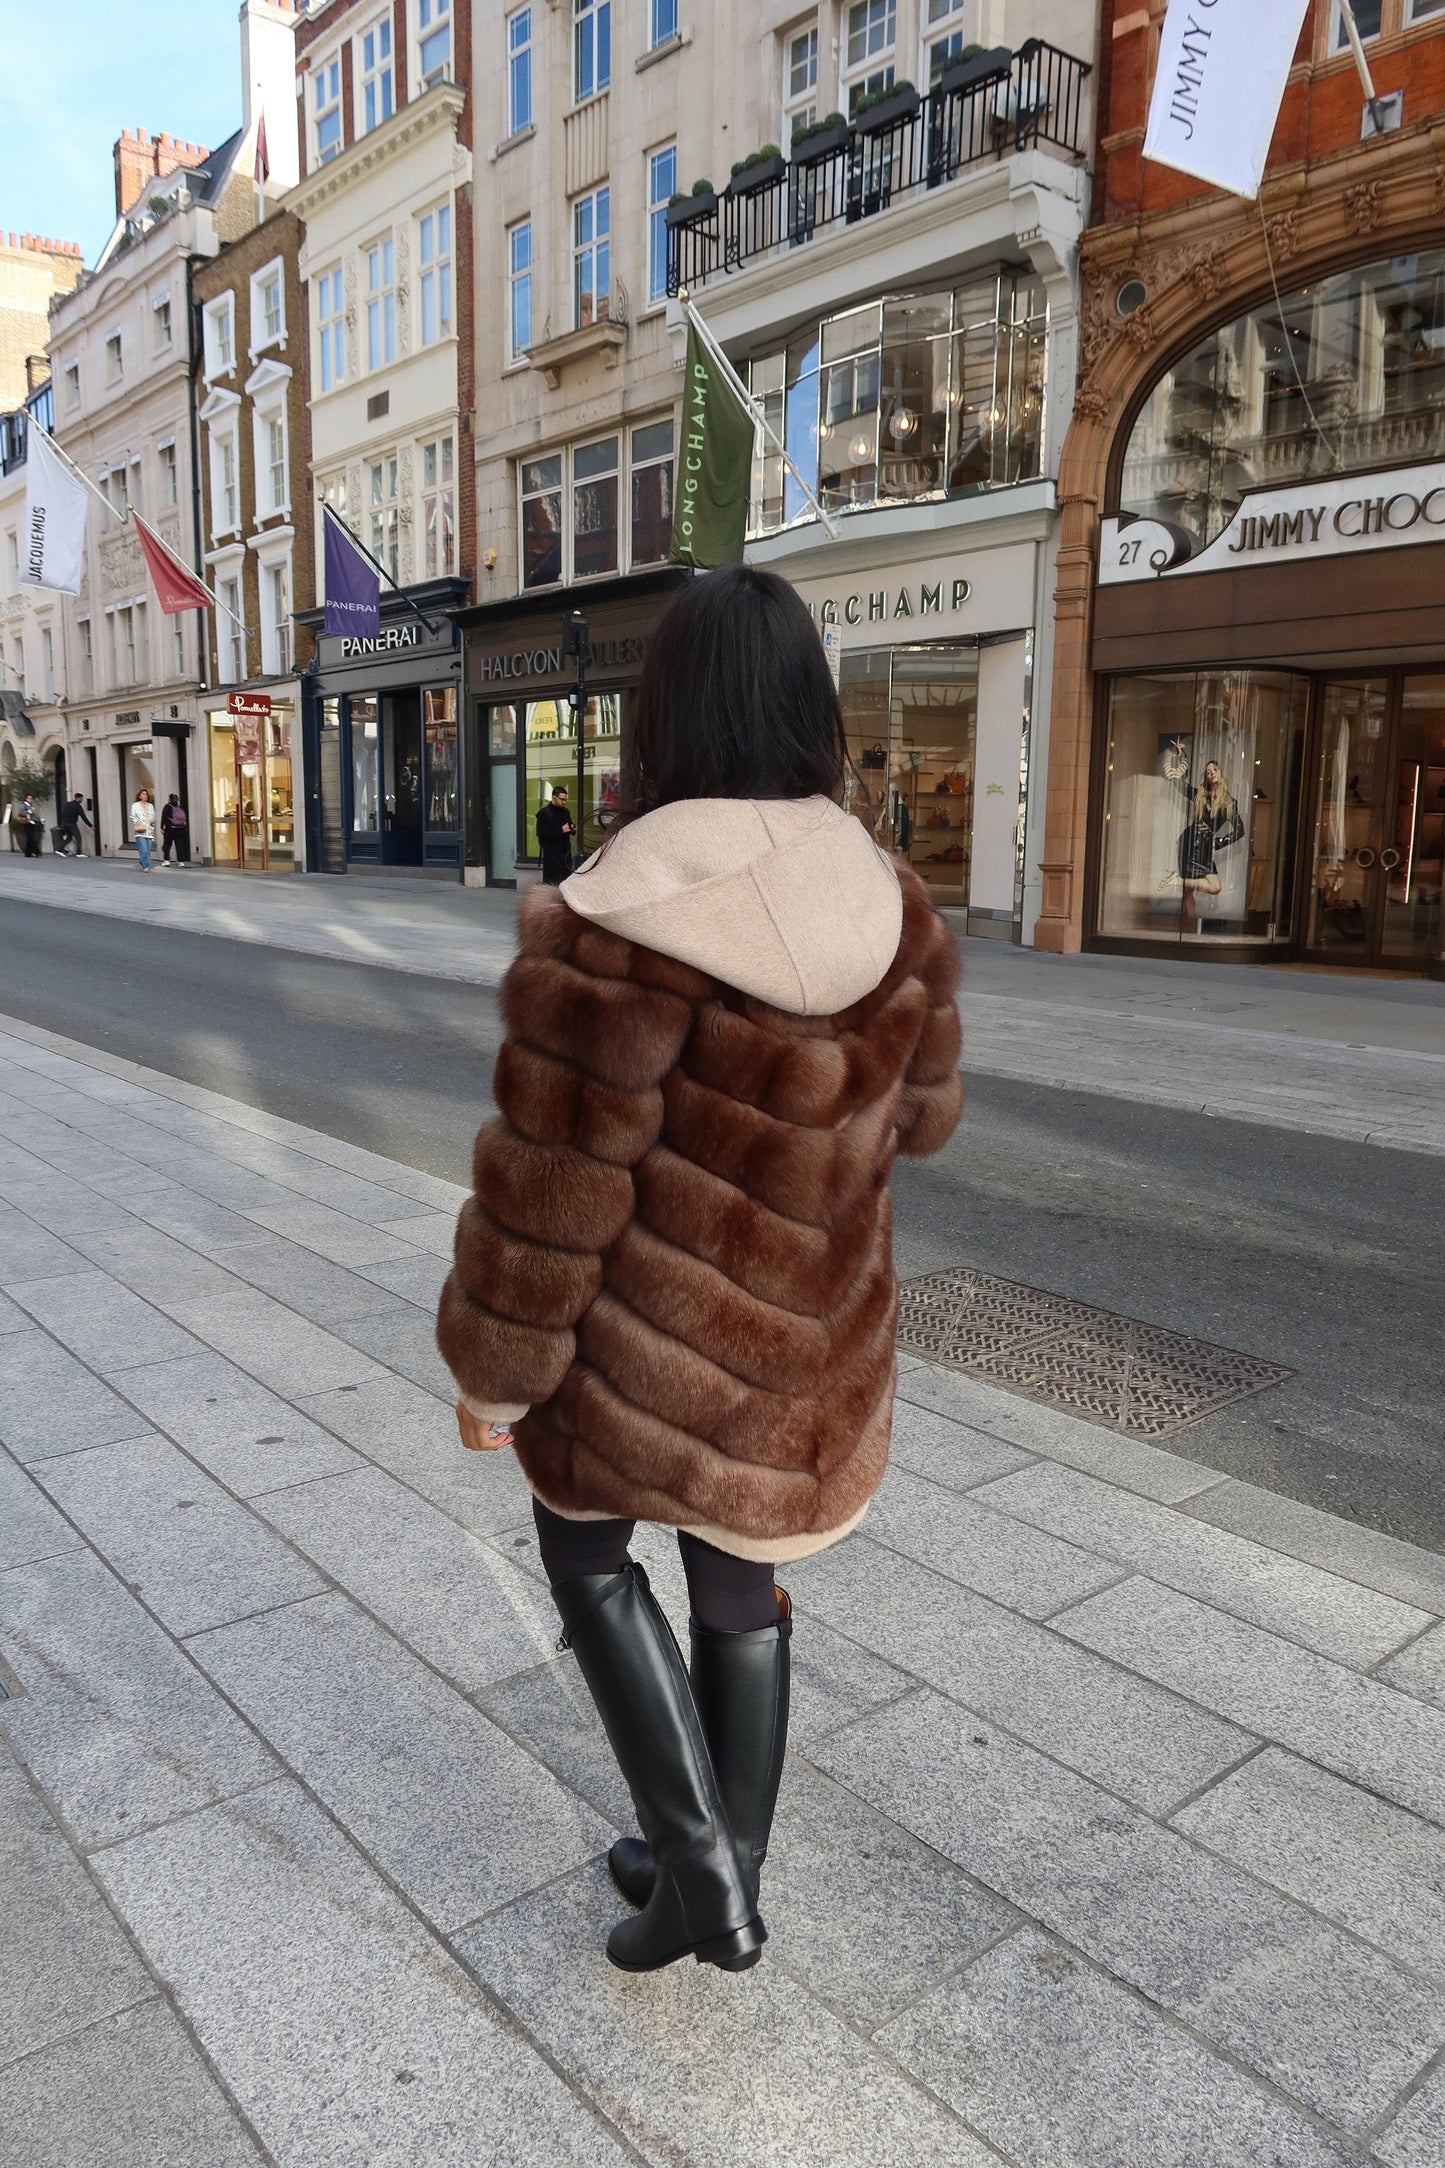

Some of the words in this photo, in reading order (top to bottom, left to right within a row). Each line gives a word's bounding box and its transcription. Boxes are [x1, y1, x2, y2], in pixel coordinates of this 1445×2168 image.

[1169, 14, 1212, 140] JIMMY
[679, 363, 709, 553] LONGCHAMP
[28, 505, 46, 581] JACQUEMUS
[1228, 506, 1327, 552] JIMMY
[1118, 540, 1142, 566] 27
[326, 599, 377, 613] PANERAI
[809, 579, 972, 625] GCHAMP
[341, 626, 418, 657] PANERAI
[481, 647, 561, 681] HALCYON
